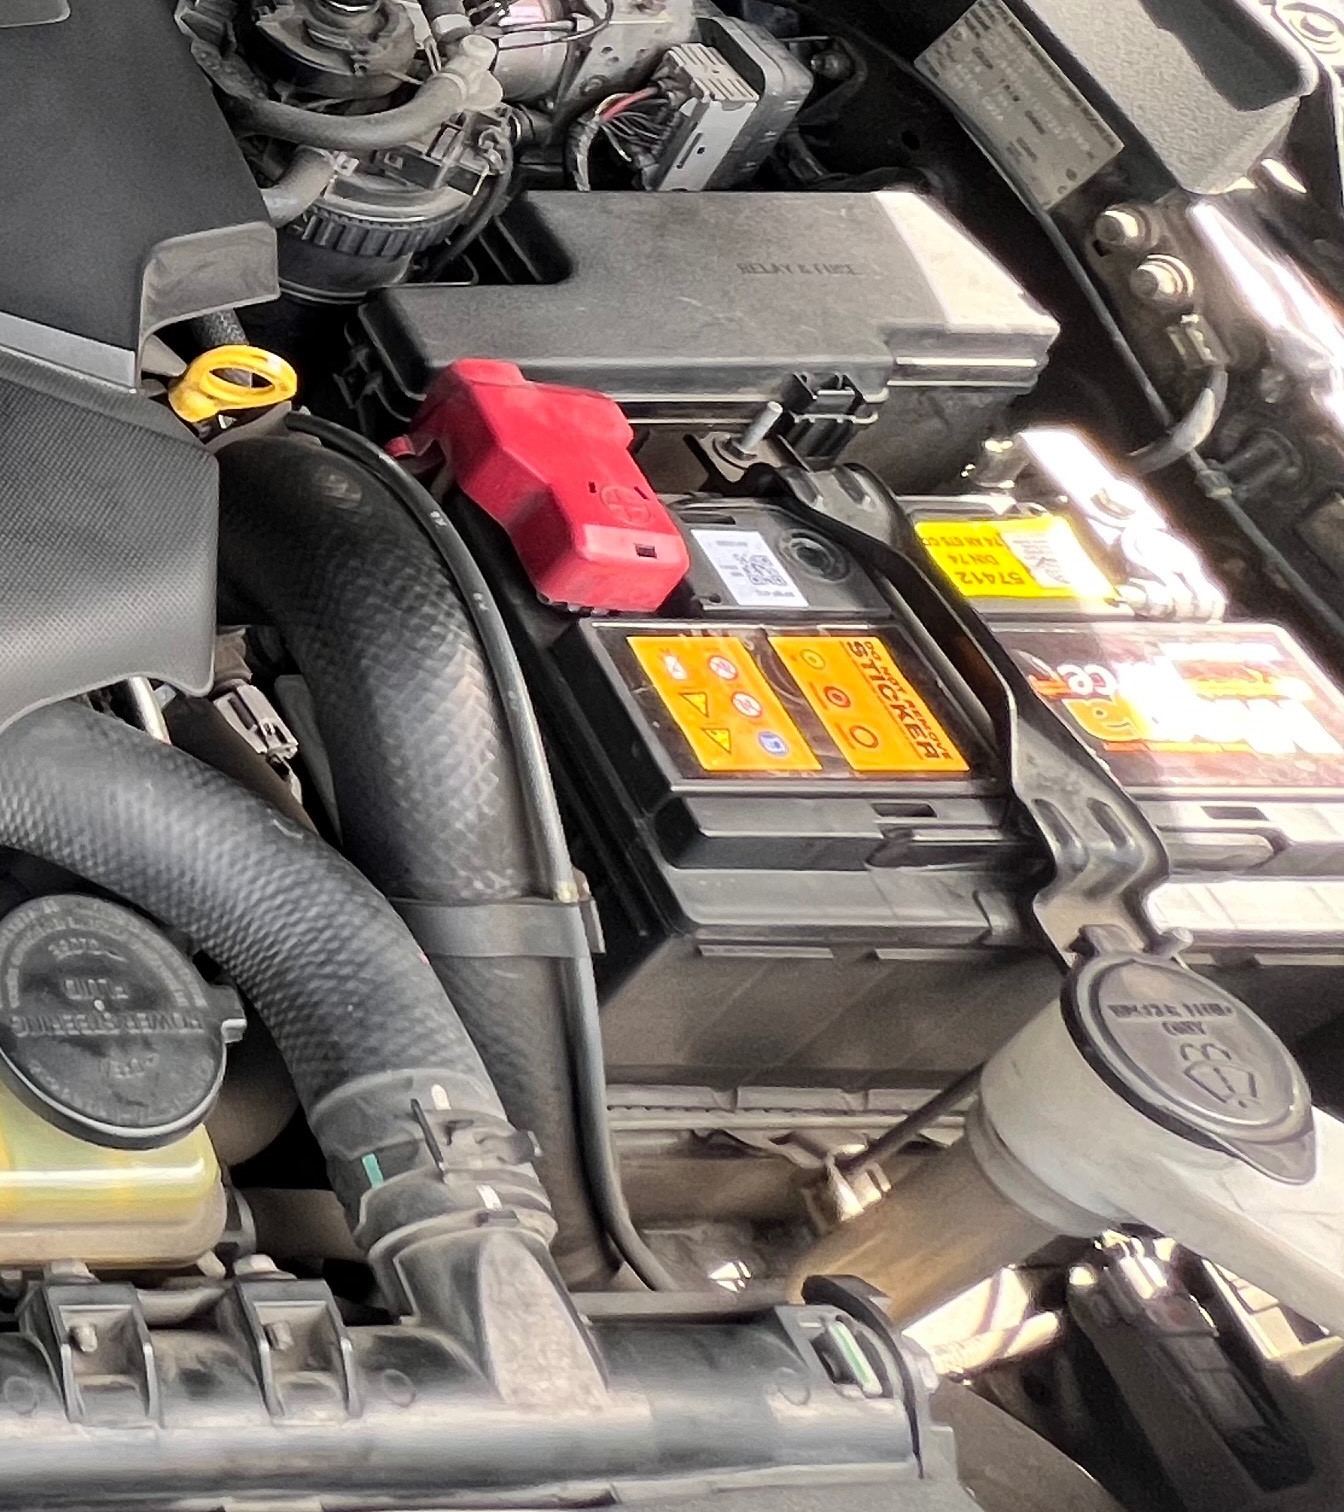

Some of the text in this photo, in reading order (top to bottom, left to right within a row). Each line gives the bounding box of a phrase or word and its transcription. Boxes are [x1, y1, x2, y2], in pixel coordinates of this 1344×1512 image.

[954, 571, 1026, 585] 57412
[847, 641, 942, 759] STICKER
[864, 641, 952, 761] DO NOT REMOVE
[10, 1012, 205, 1038] POWER STEERING
